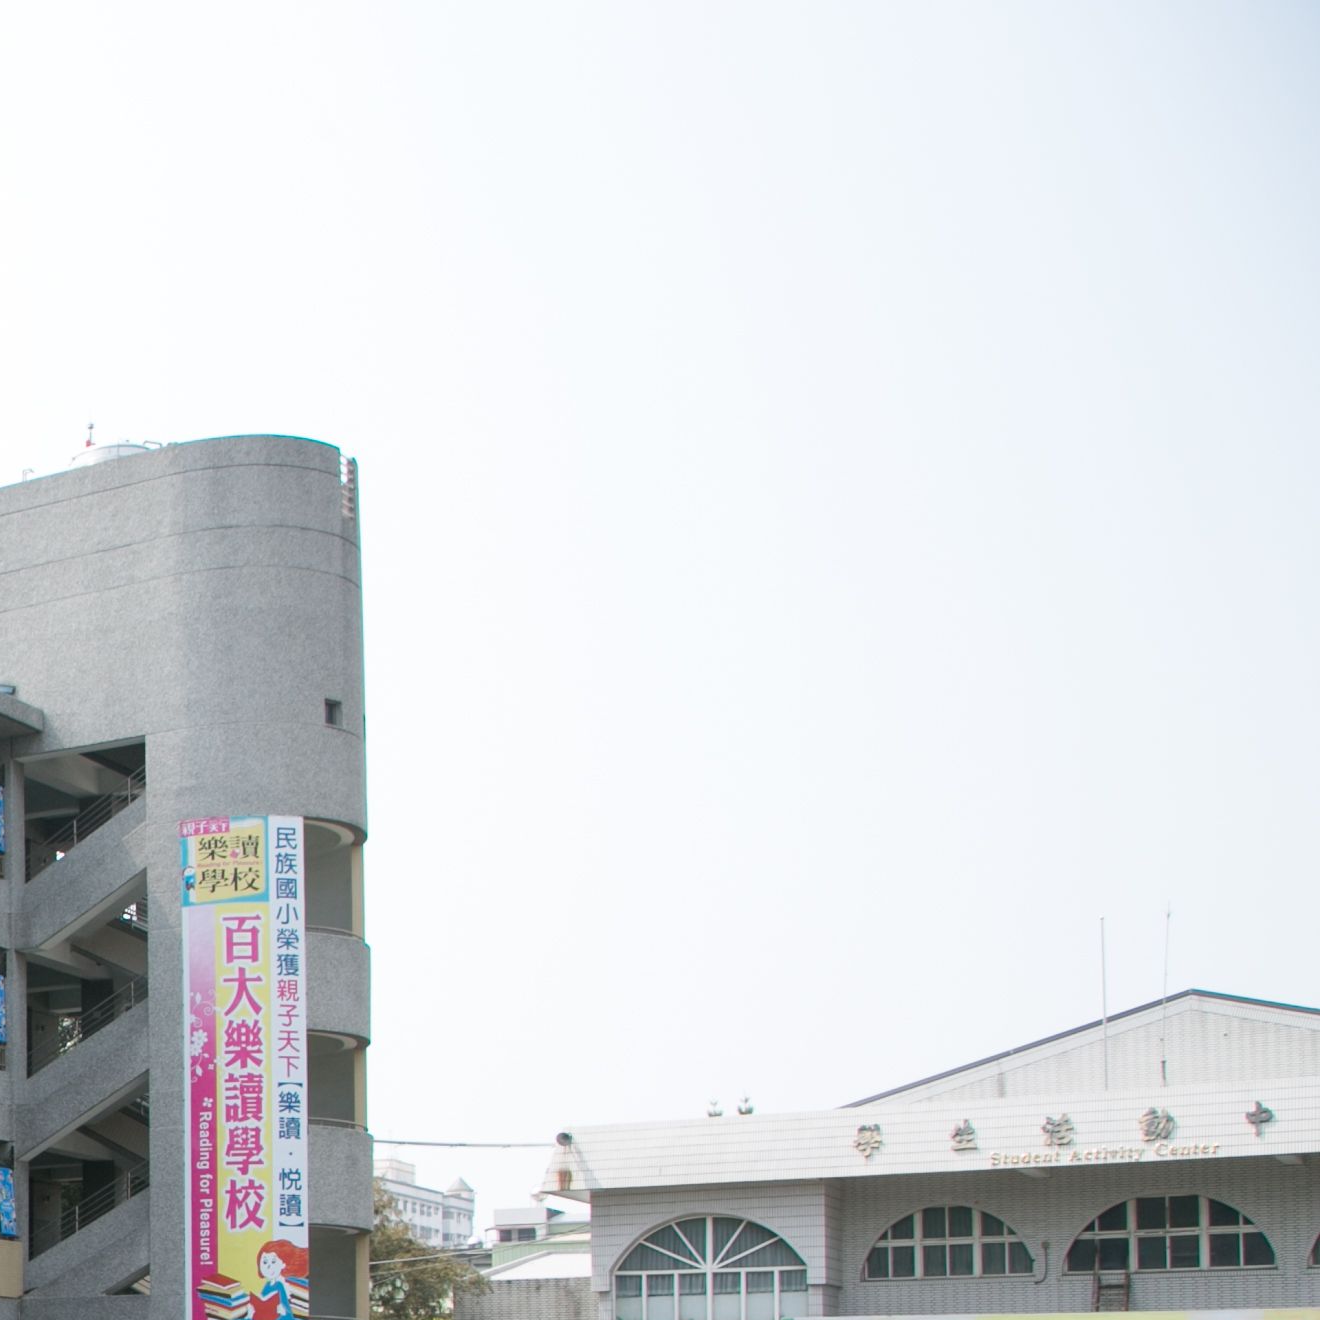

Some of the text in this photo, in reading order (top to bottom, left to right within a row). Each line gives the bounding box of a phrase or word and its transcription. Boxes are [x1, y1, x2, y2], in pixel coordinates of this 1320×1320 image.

[198, 867, 260, 893] 學校
[222, 914, 265, 1230] 百大樂讀學校
[197, 1111, 213, 1266] Reading for Pleasure!
[989, 1141, 1221, 1167] Student Activity Center
